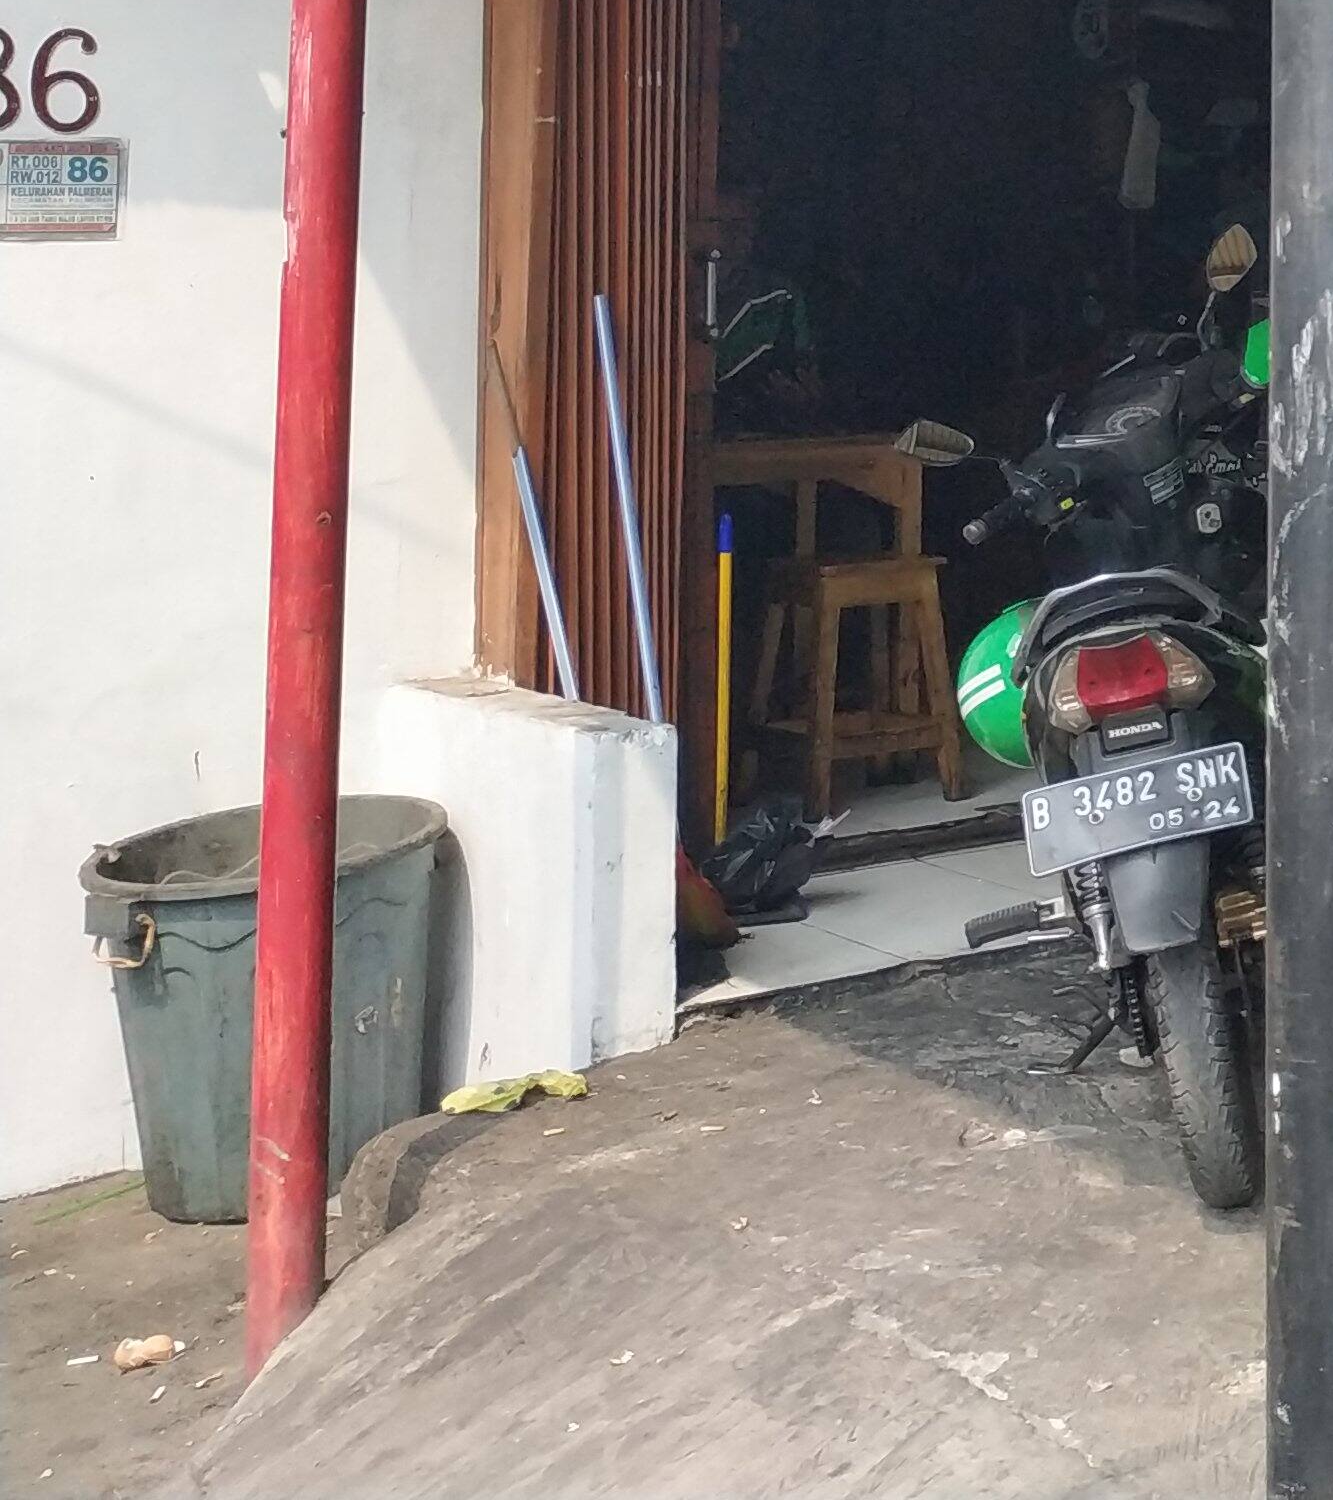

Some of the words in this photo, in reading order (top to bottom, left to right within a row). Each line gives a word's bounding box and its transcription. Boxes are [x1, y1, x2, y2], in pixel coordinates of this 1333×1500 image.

[67, 155, 109, 183] 86
[1107, 720, 1165, 739] HONDA
[1032, 796, 1051, 831] B
[1072, 770, 1158, 818] 3482
[1174, 751, 1241, 794] SNK
